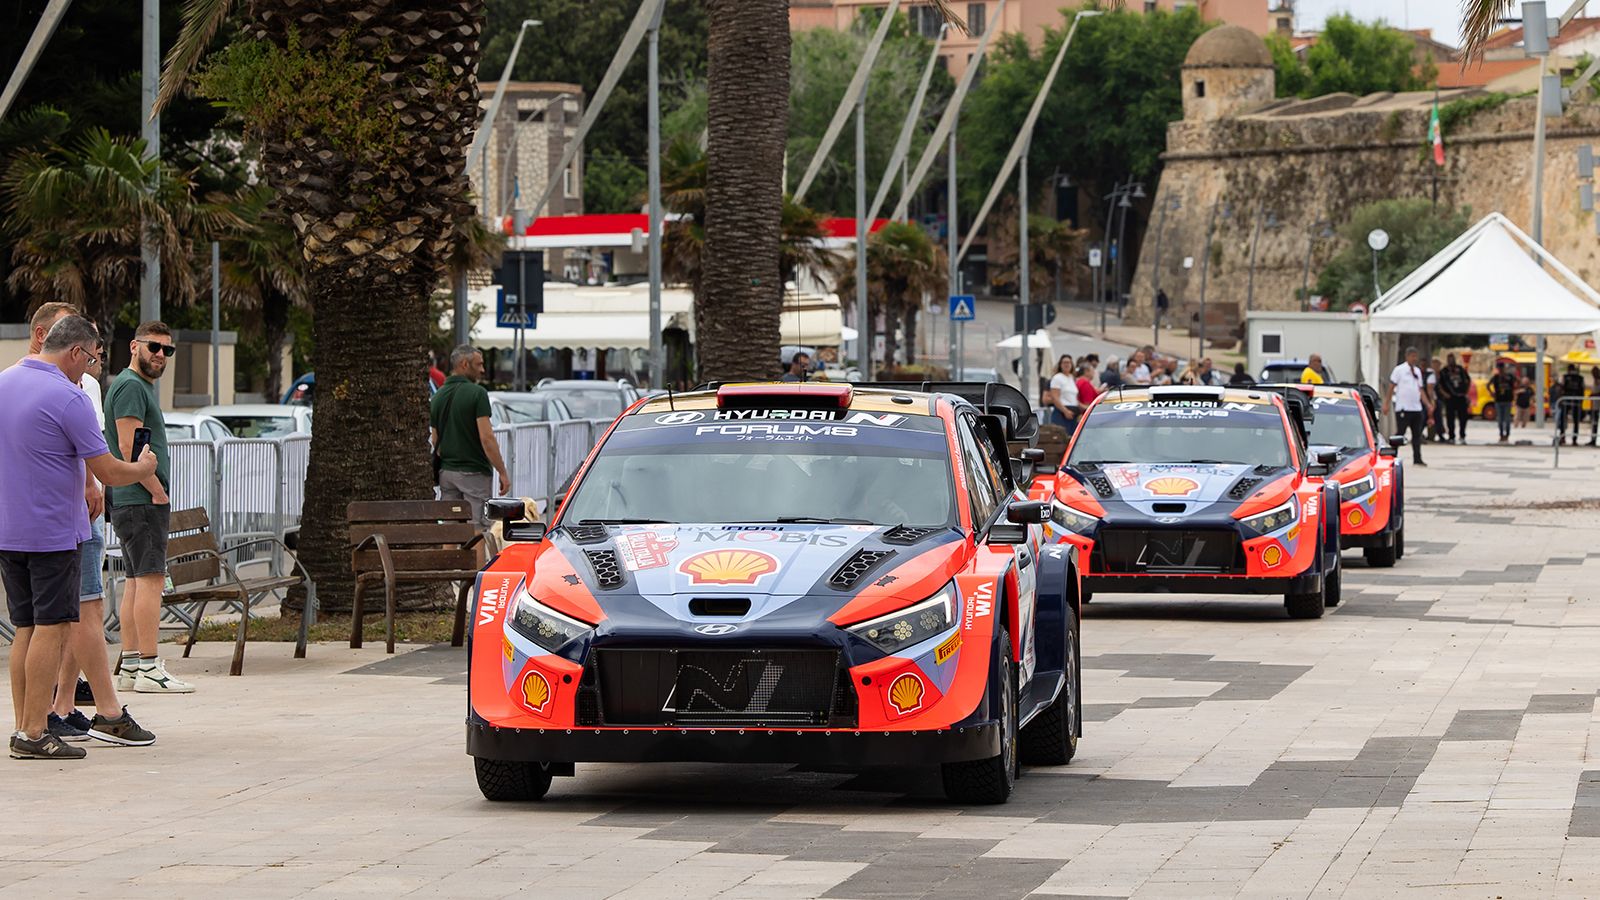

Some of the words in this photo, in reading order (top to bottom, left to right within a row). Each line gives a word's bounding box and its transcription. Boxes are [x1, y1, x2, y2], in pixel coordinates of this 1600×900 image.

[713, 410, 835, 421] HYUNDAI
[696, 424, 858, 437] FORUM8
[693, 531, 849, 547] MOBIS
[498, 578, 510, 609] HYUNDAI
[965, 597, 975, 630] HYUNDAI
